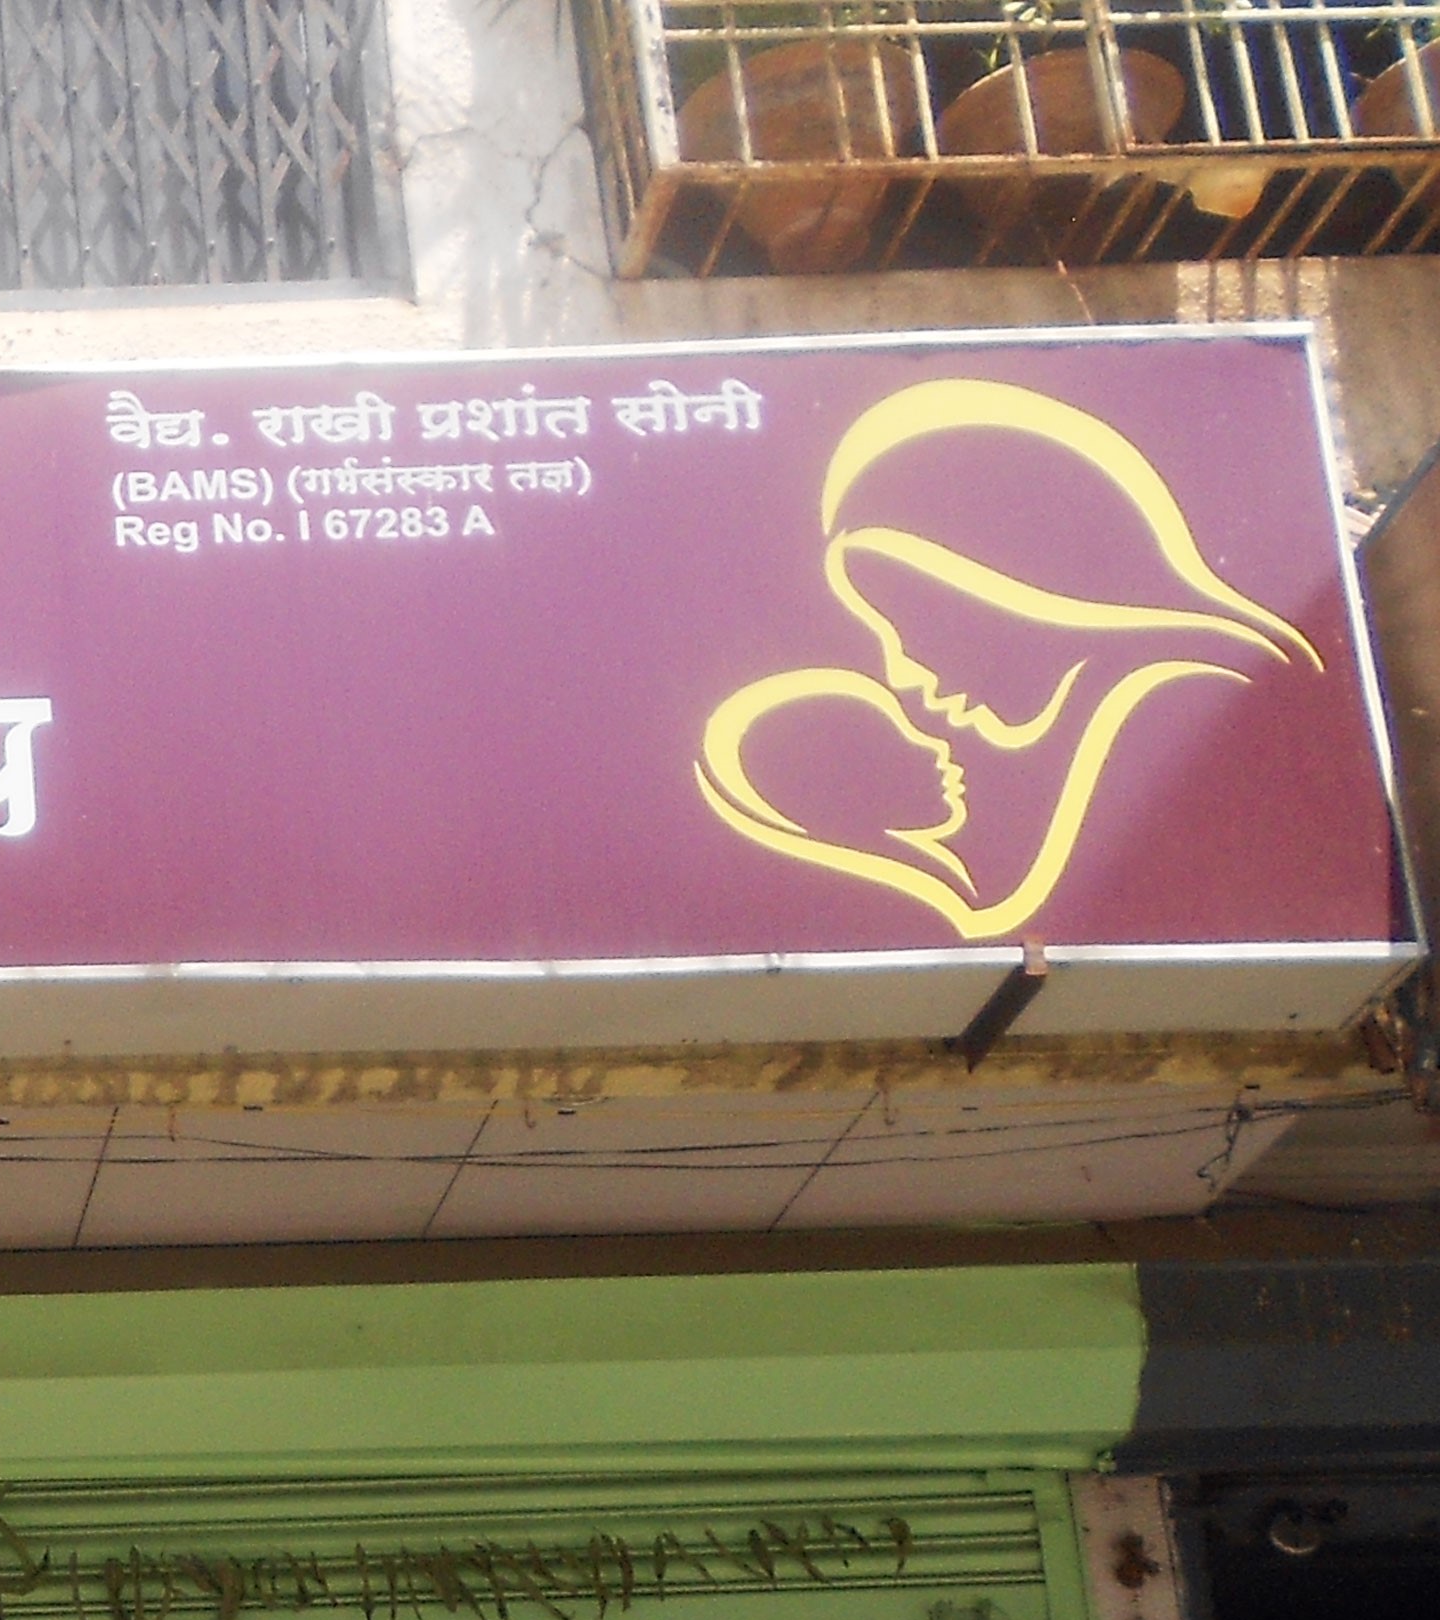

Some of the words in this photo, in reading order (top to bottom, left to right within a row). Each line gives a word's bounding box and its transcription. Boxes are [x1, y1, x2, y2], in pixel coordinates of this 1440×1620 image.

[106, 389, 230, 449] वैद्य.
[252, 392, 397, 447] राखी
[417, 382, 592, 441] प्रशांत
[611, 378, 763, 436] सोनी
[111, 468, 275, 510] (BAMS)
[287, 456, 494, 504] (गर्भसंस्कार
[506, 455, 593, 498] तज्ञ)
[114, 515, 198, 552] Reg
[214, 511, 285, 544] No.
[324, 506, 449, 540] 67283
[461, 504, 495, 536] A
